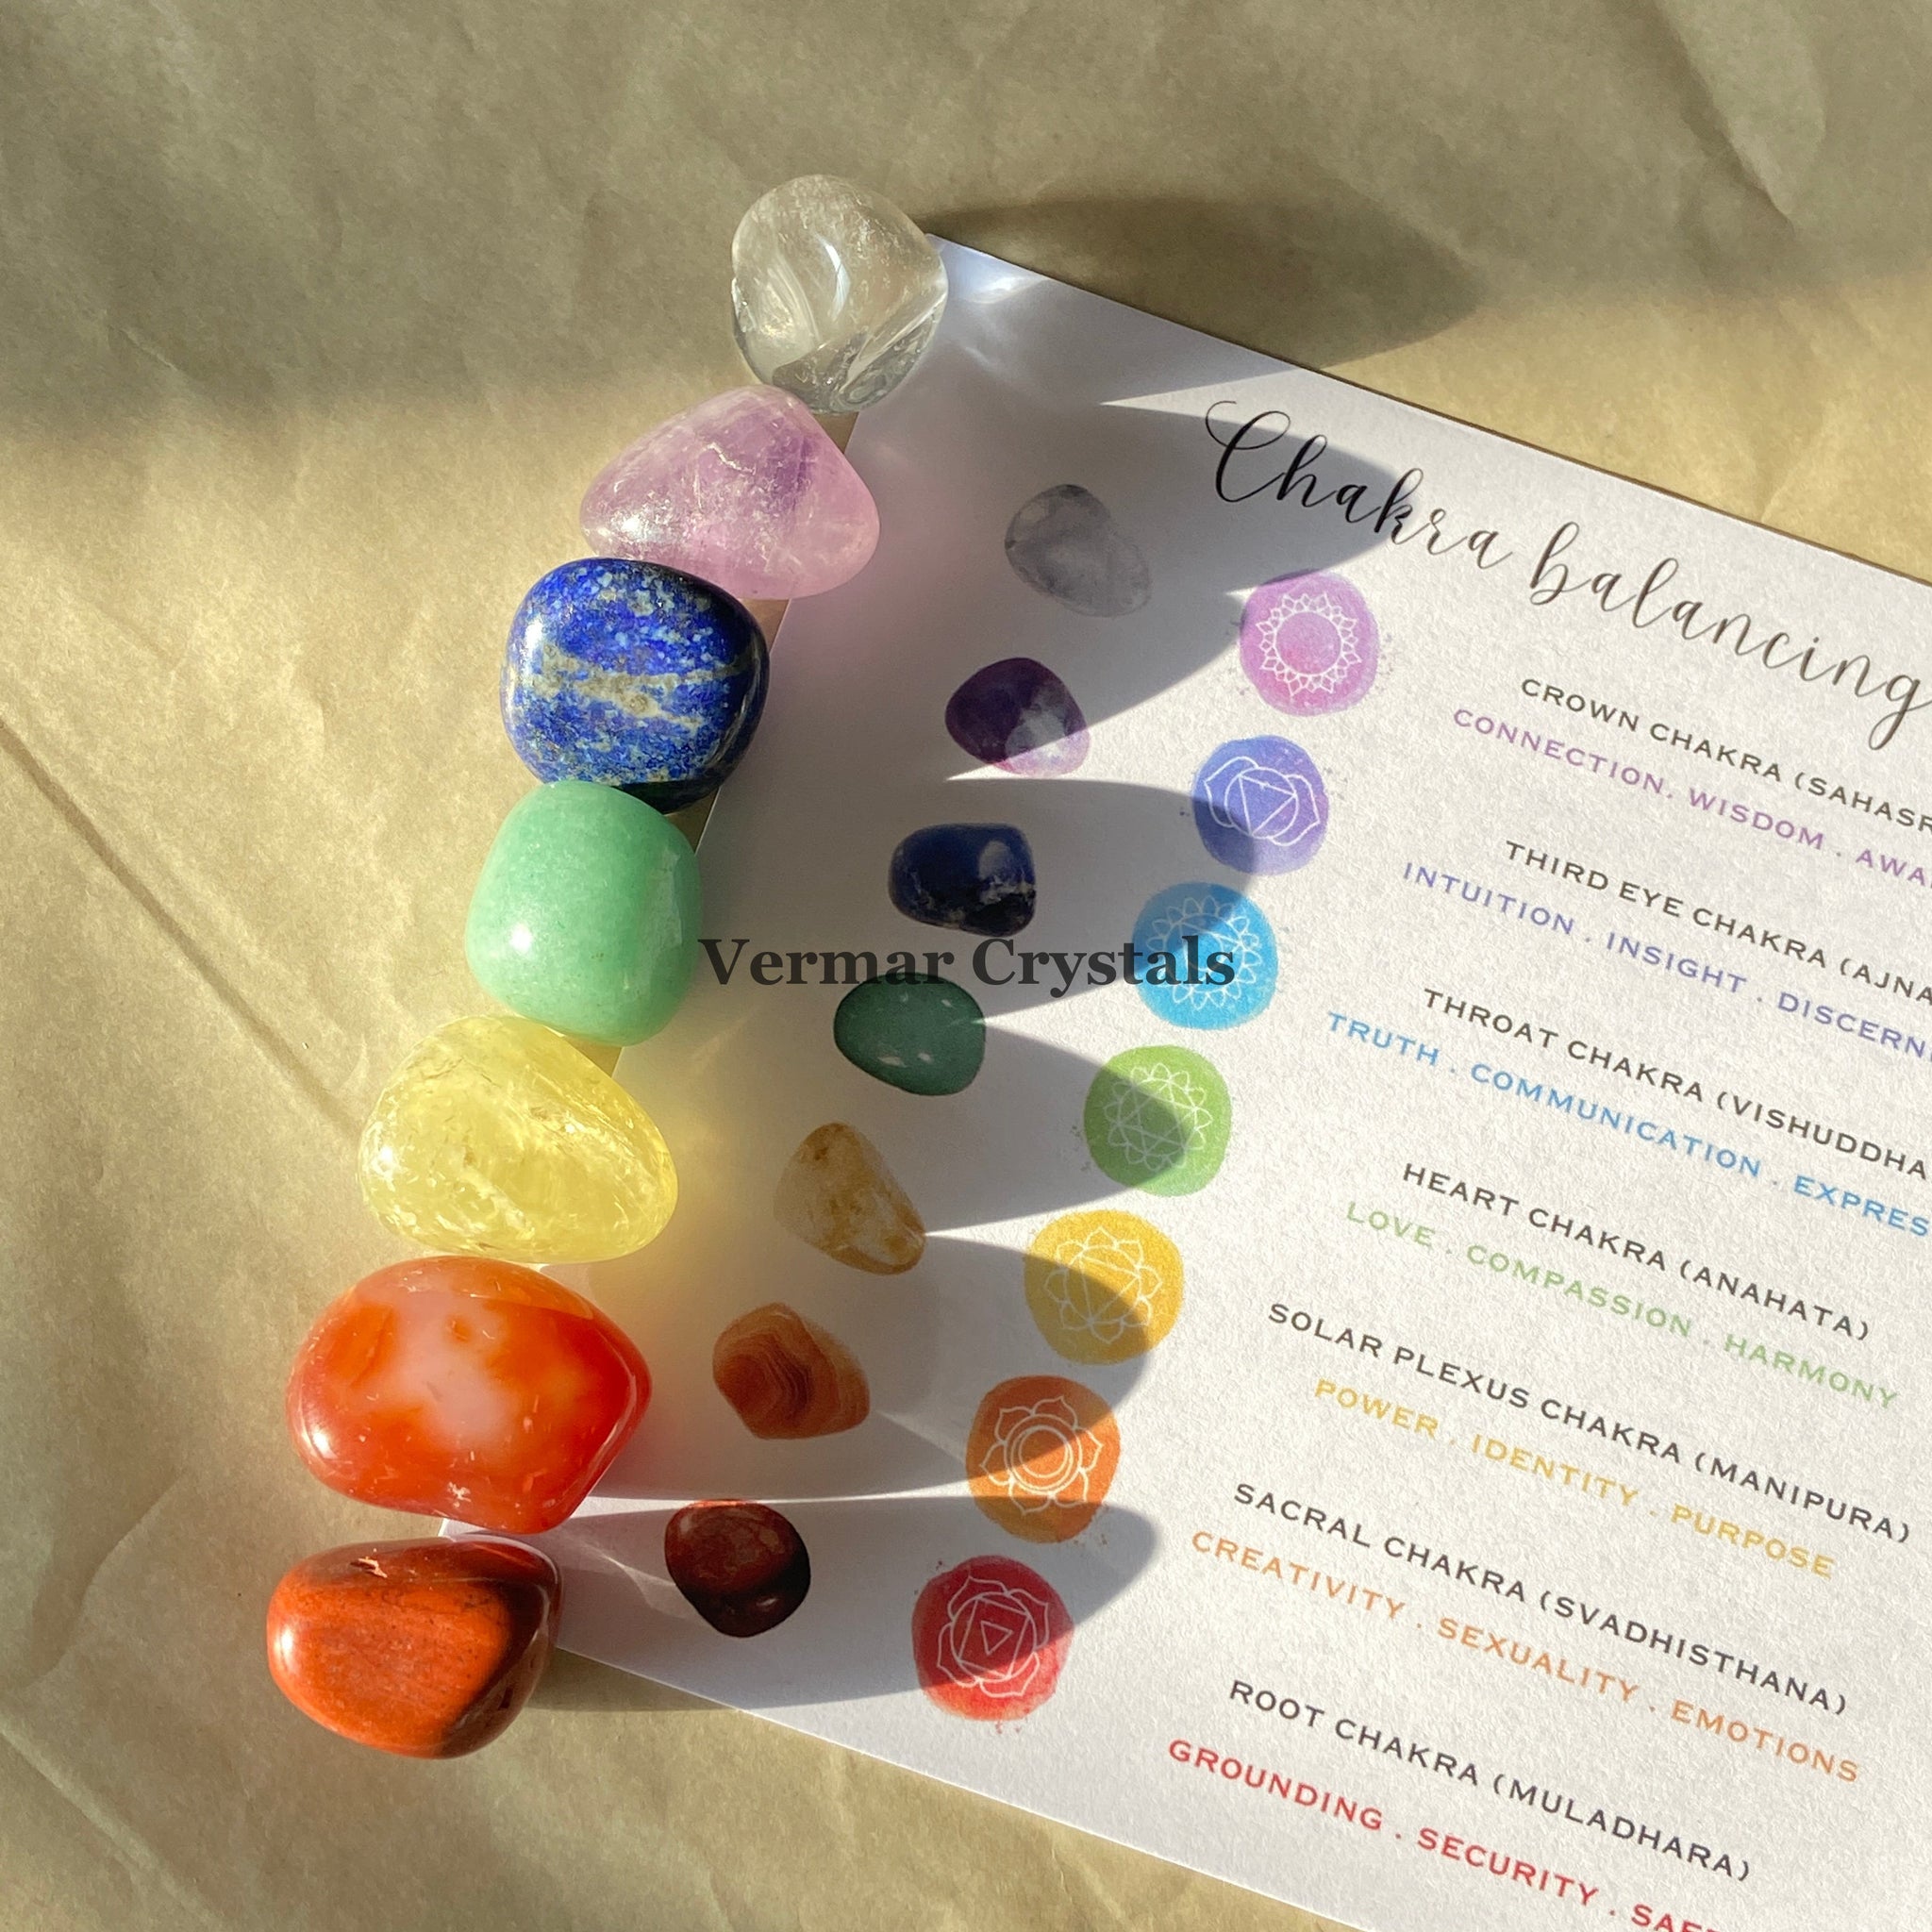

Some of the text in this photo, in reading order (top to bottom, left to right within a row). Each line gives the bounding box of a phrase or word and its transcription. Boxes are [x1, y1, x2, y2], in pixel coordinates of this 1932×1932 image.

[1205, 400, 1932, 751] Chakra balancing
[1521, 678, 1640, 732] CROWN
[1649, 723, 1781, 783] CHAKRA
[1506, 840, 1932, 1007] THIRD EYE CHAKRA (AJNA
[1690, 788, 1824, 851] WISDOM
[1855, 848, 1932, 890] AWA
[1403, 862, 1932, 1063] INTUITION INSIGHT DISCERN
[1328, 1011, 1930, 1237] TRUTH COMMUNICATION EXPRES
[1424, 987, 1927, 1181] THROAT CHAKRA (VISHUDDHA
[1346, 1201, 1897, 1408] LOVE COMPASSION HARMONY
[1403, 1162, 1869, 1341] HEART CHAKRA (ANAHATA)
[1268, 1302, 1910, 1544] SOLAR PLEXUS CHAKRA (MANIPURA)
[1314, 1377, 1834, 1579] POWER IDENTITY PURPOSE
[1191, 1530, 1858, 1782] CREATIVITY SEXUALITY EMOTIONS
[1233, 1483, 1846, 1716] SACRAL CHAKRA (SVADHISTHANA)
[1168, 1739, 1721, 1932] GROUNDING SECURITY SAF
[1229, 1679, 1750, 1882] ROOT CHAKRA (MULADHARA)
